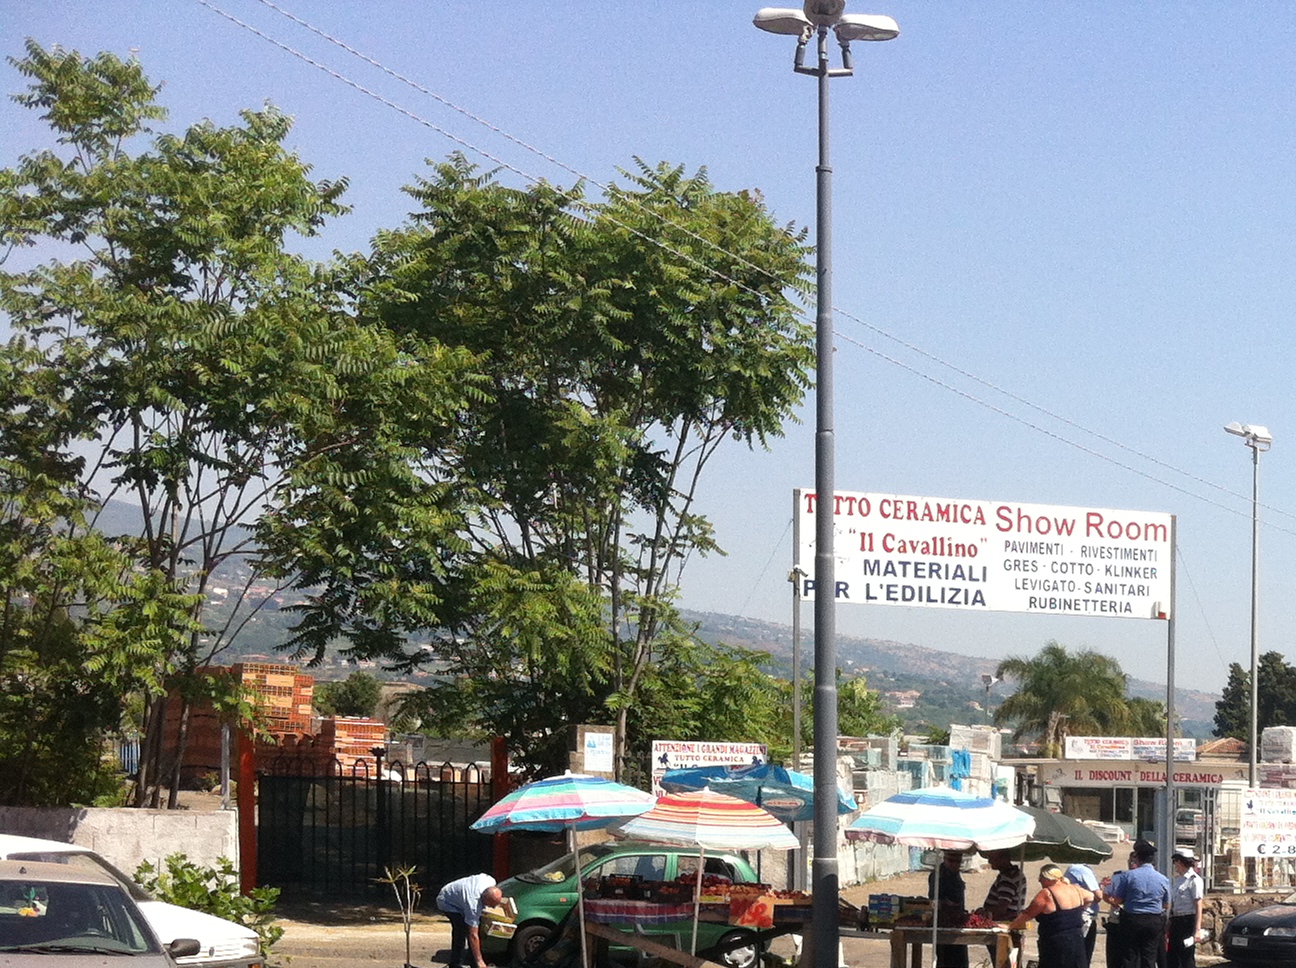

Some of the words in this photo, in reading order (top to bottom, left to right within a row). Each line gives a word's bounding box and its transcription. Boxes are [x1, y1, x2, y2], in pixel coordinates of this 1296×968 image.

[805, 493, 871, 517] TTTO
[879, 499, 986, 525] CERAMICA
[996, 506, 1076, 537] Show
[1086, 512, 1168, 542] Room
[1004, 541, 1064, 555] PAVIMENTI
[1081, 545, 1158, 562] RIVESTIMENTI
[864, 559, 988, 582] MATERIALI
[1003, 559, 1038, 573] GRES
[1051, 561, 1094, 576] COTTO
[1105, 564, 1158, 580] KLINKER
[804, 581, 850, 599] PR
[866, 583, 986, 606] L'EDILIZIA
[1029, 597, 1132, 614] RUBINETTERIA
[1075, 770, 1083, 780] IL
[1089, 770, 1131, 781] DISCOUNT
